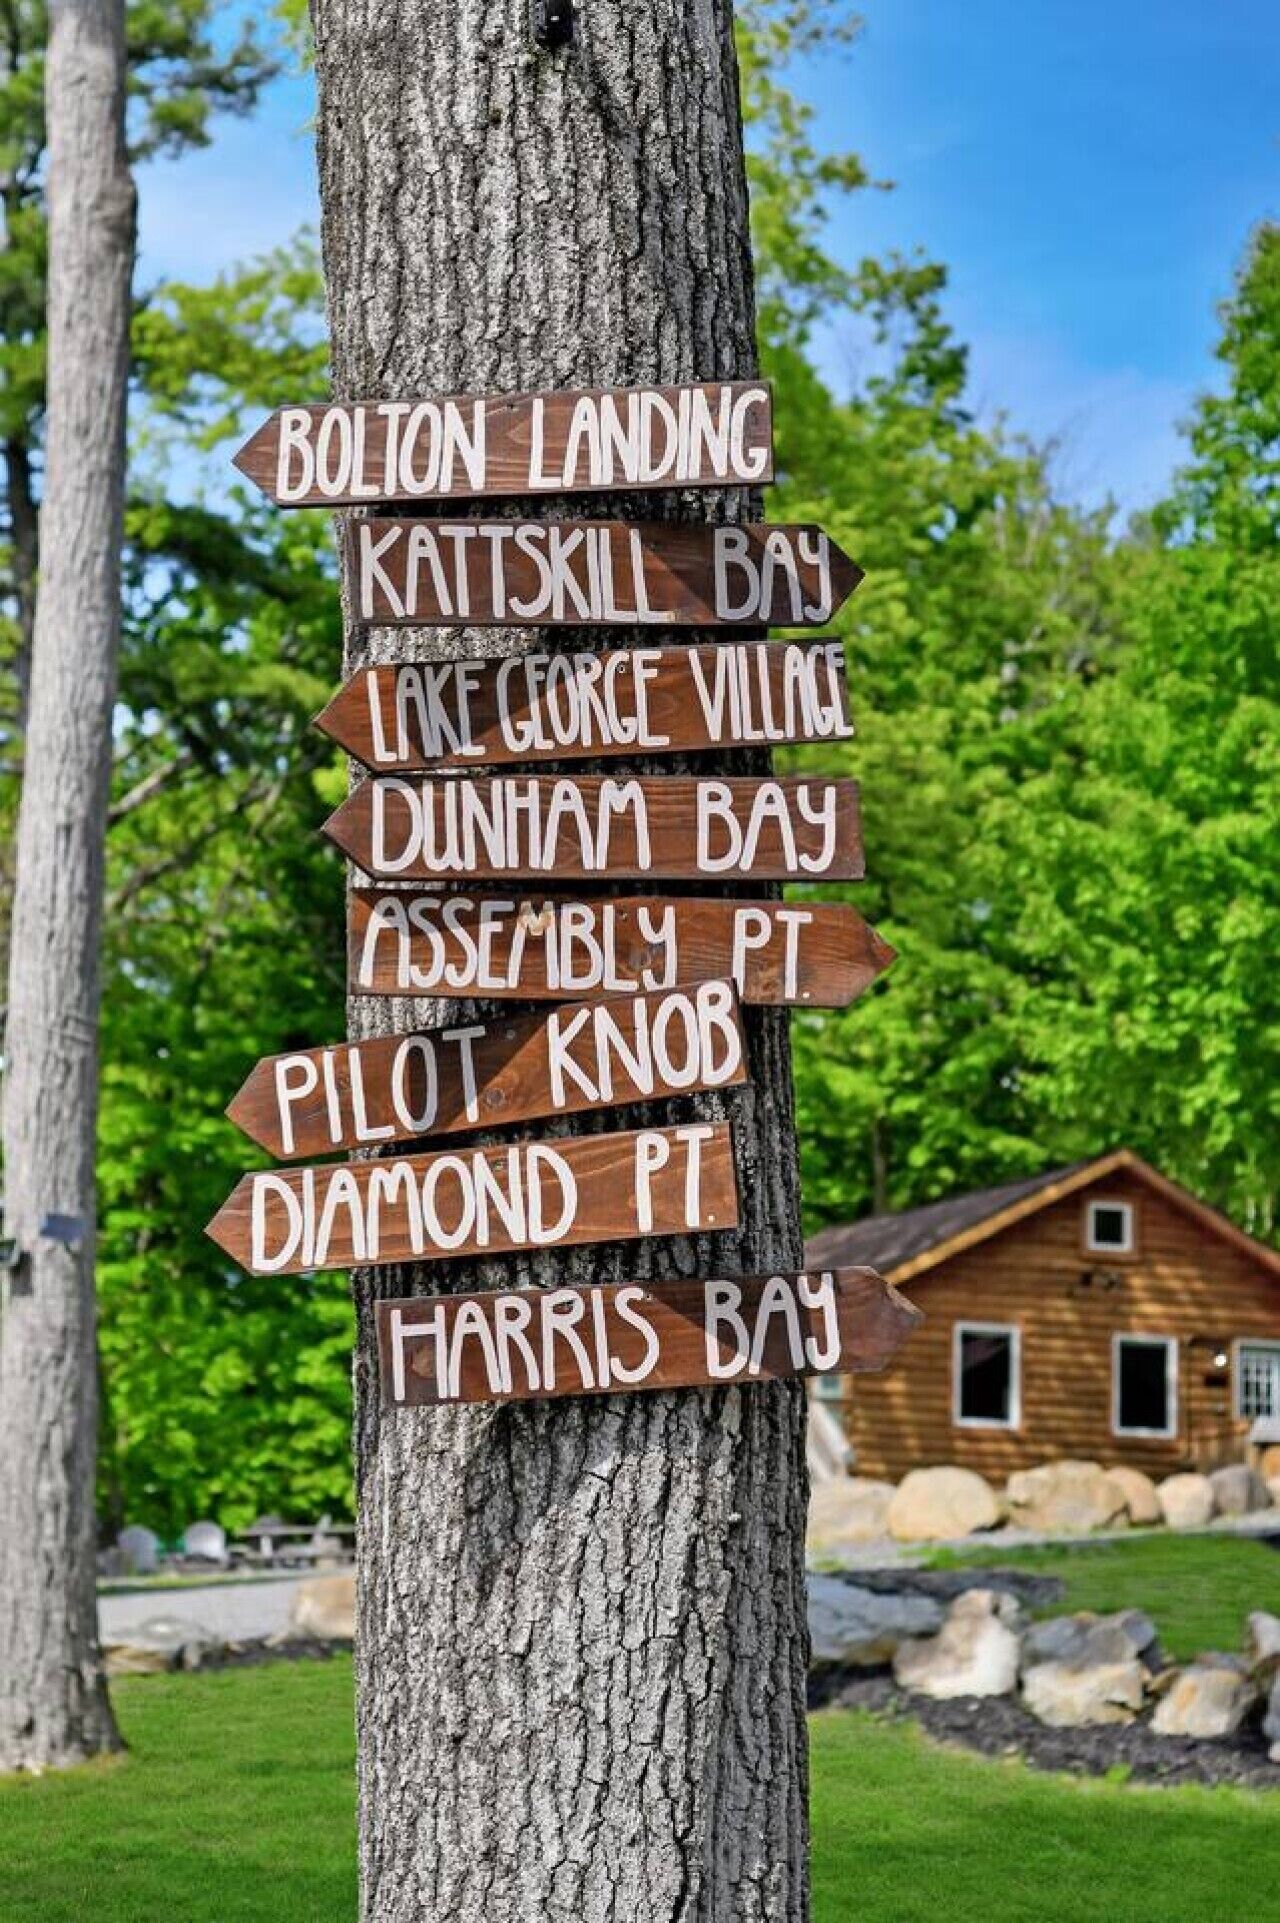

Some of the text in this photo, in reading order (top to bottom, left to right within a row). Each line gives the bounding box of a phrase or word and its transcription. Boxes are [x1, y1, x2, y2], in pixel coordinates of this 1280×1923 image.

[276, 386, 769, 500] BOLTON LANDING
[359, 524, 833, 624] KATTSKILL BAY
[366, 643, 854, 762] LAKE GEORGE VILLAGE
[371, 778, 837, 873] DUNHAM BAY
[358, 897, 813, 999] ASSEMBLY PT.
[273, 980, 742, 1154] PILOT KNOB
[251, 1126, 715, 1272] DIAMOND PT.
[390, 1271, 842, 1400] HARRIS BAY
